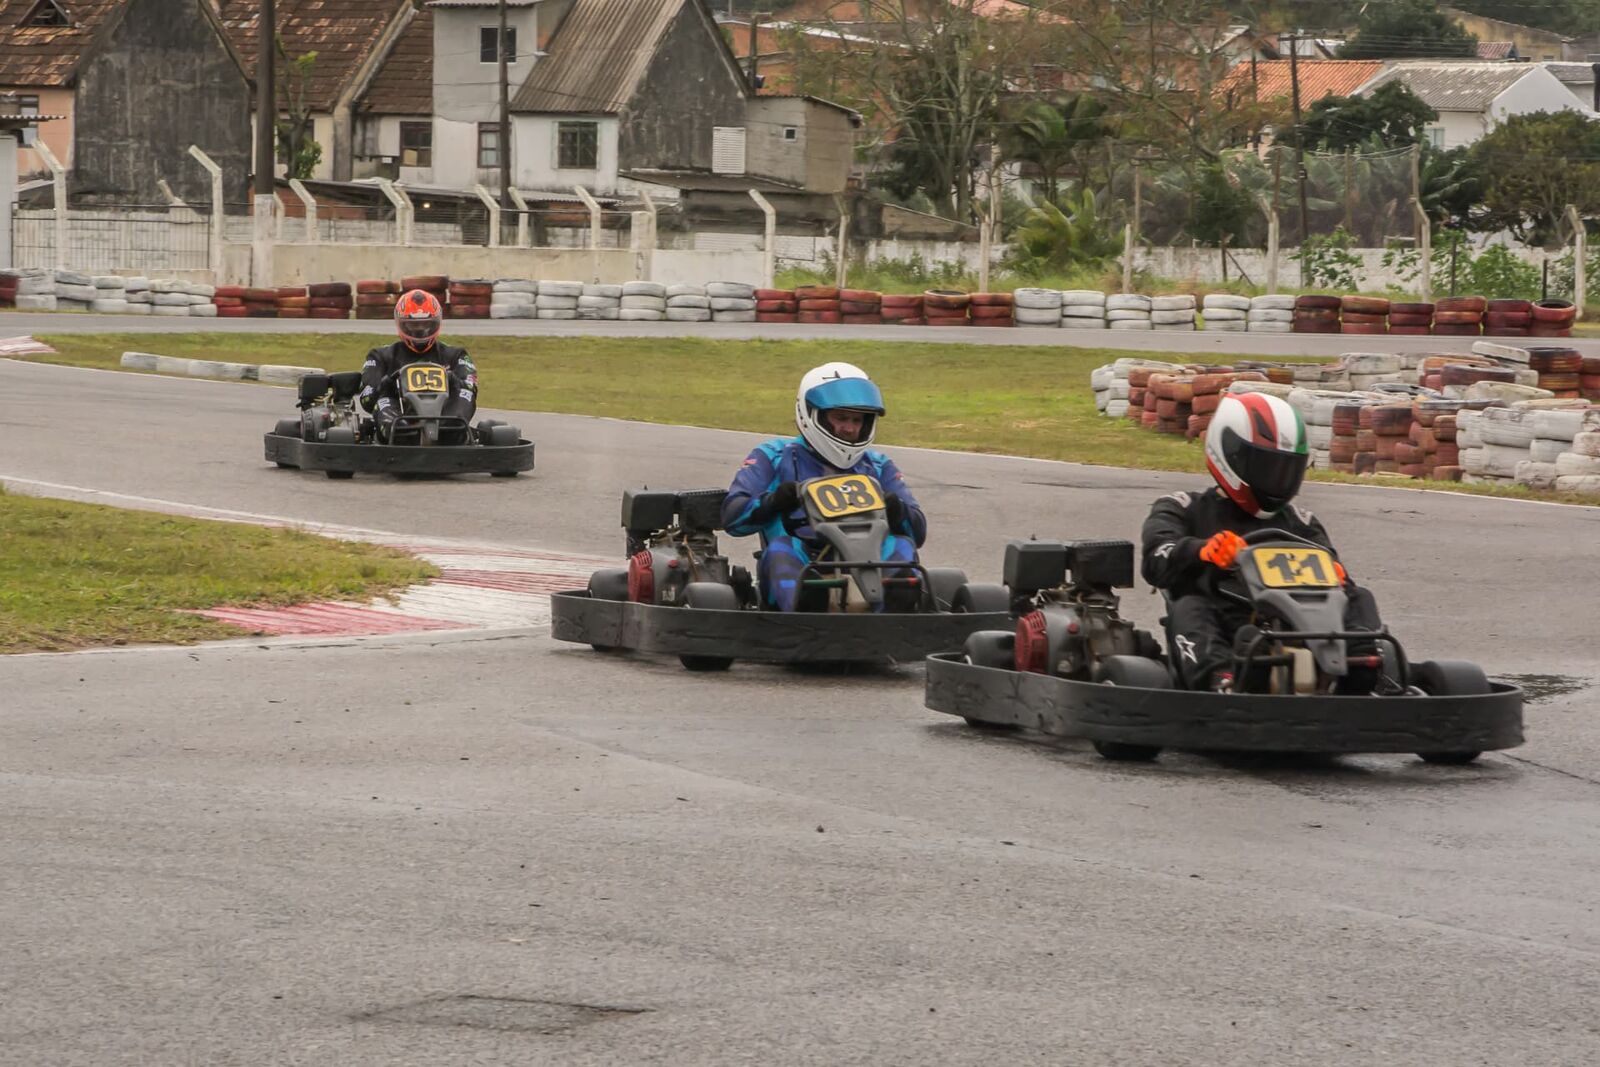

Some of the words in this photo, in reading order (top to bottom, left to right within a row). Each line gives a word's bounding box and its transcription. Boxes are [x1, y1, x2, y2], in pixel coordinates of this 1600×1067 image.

[411, 370, 443, 389] 05
[816, 479, 876, 513] 08
[1266, 552, 1329, 583] 11
